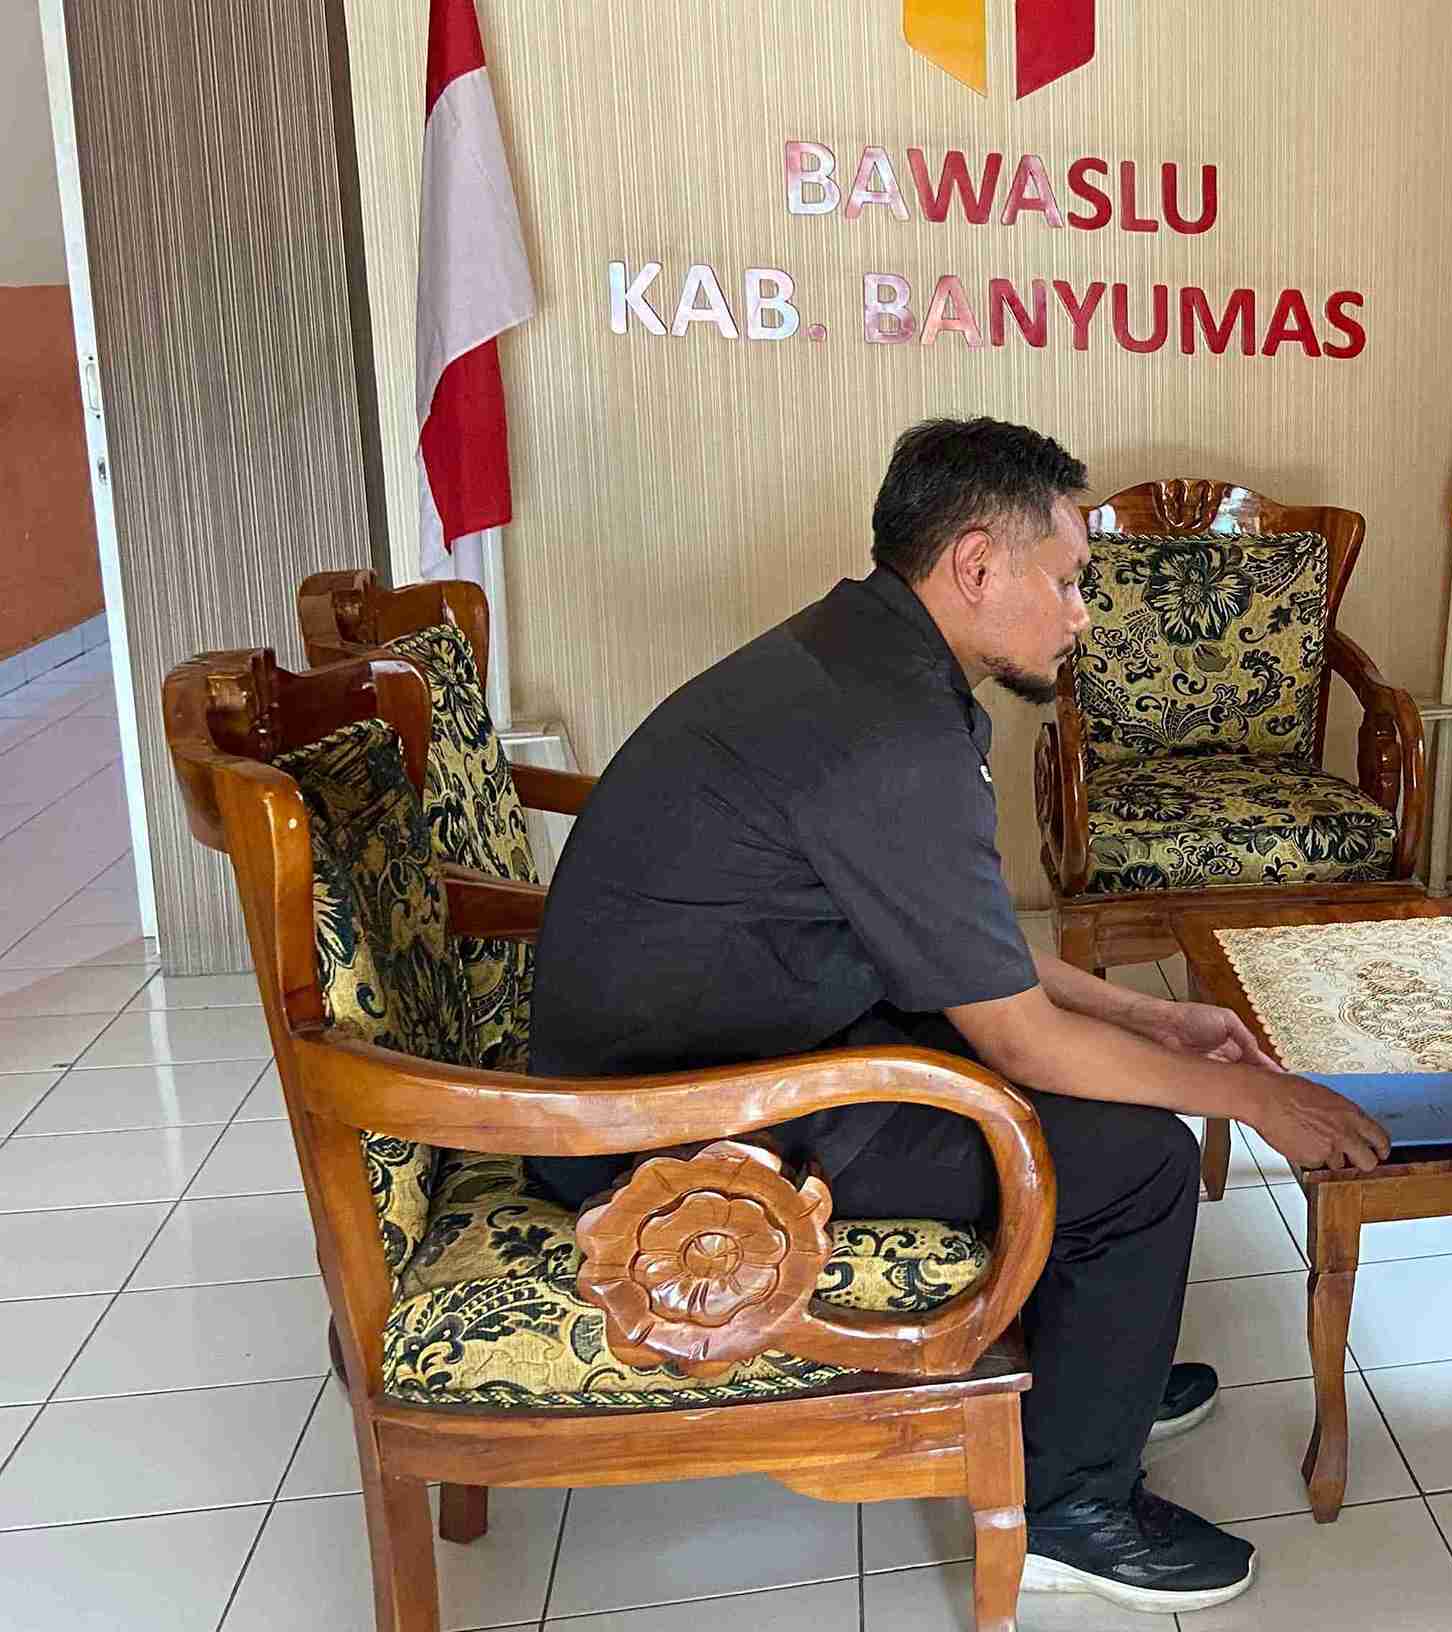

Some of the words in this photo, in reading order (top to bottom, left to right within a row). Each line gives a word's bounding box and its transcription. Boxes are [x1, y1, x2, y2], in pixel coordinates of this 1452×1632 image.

[784, 140, 1218, 235] BAWASLU
[607, 259, 828, 342] KAB.
[863, 271, 1367, 360] BANYUMAS
